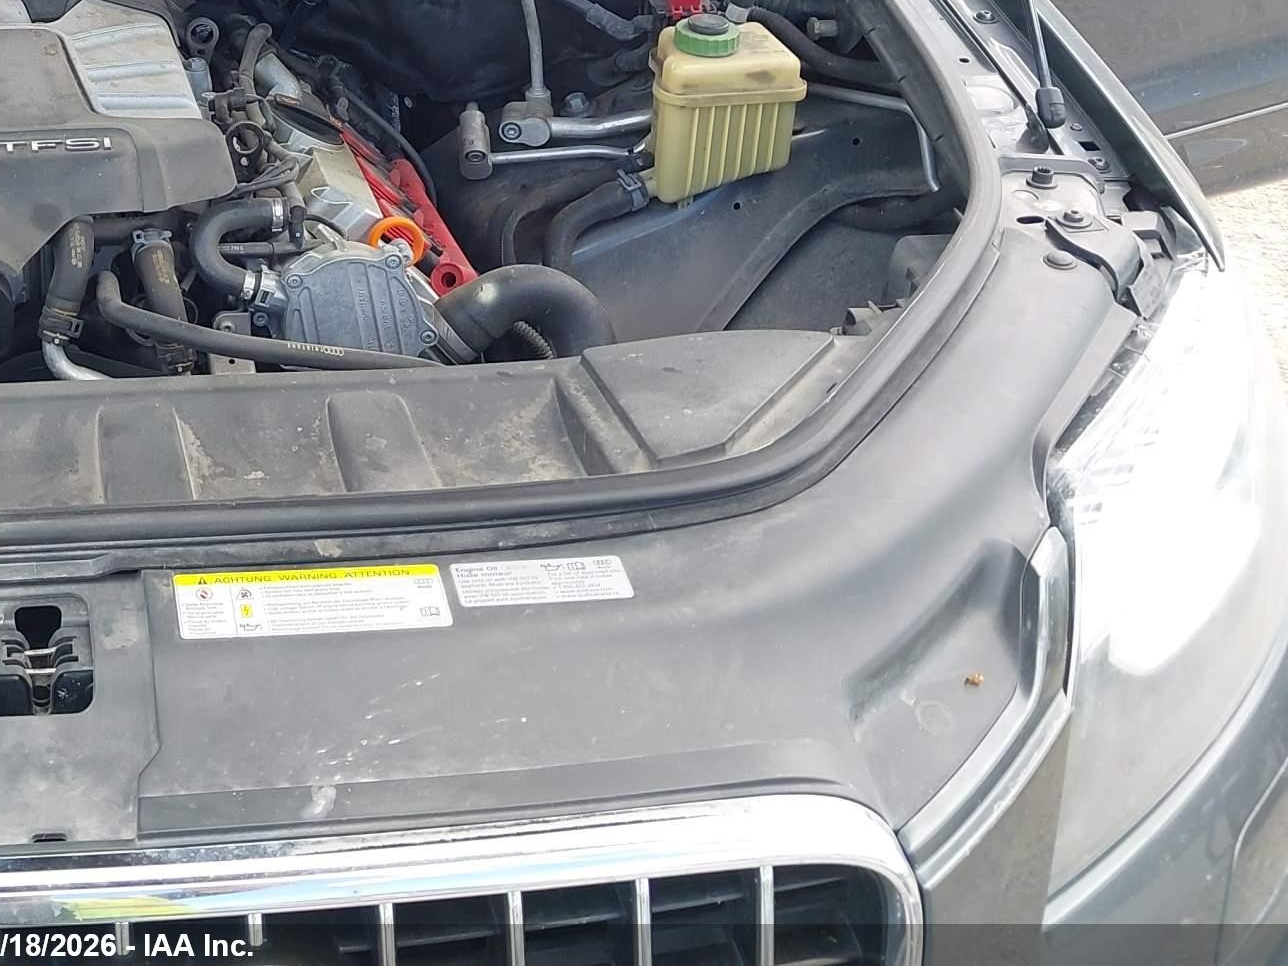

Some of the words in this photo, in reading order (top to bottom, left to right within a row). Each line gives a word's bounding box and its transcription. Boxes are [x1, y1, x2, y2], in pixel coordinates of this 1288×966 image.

[214, 575, 272, 585] ACHTUNG
[279, 572, 337, 582] WARNING
[345, 568, 411, 579] ATTENTION
